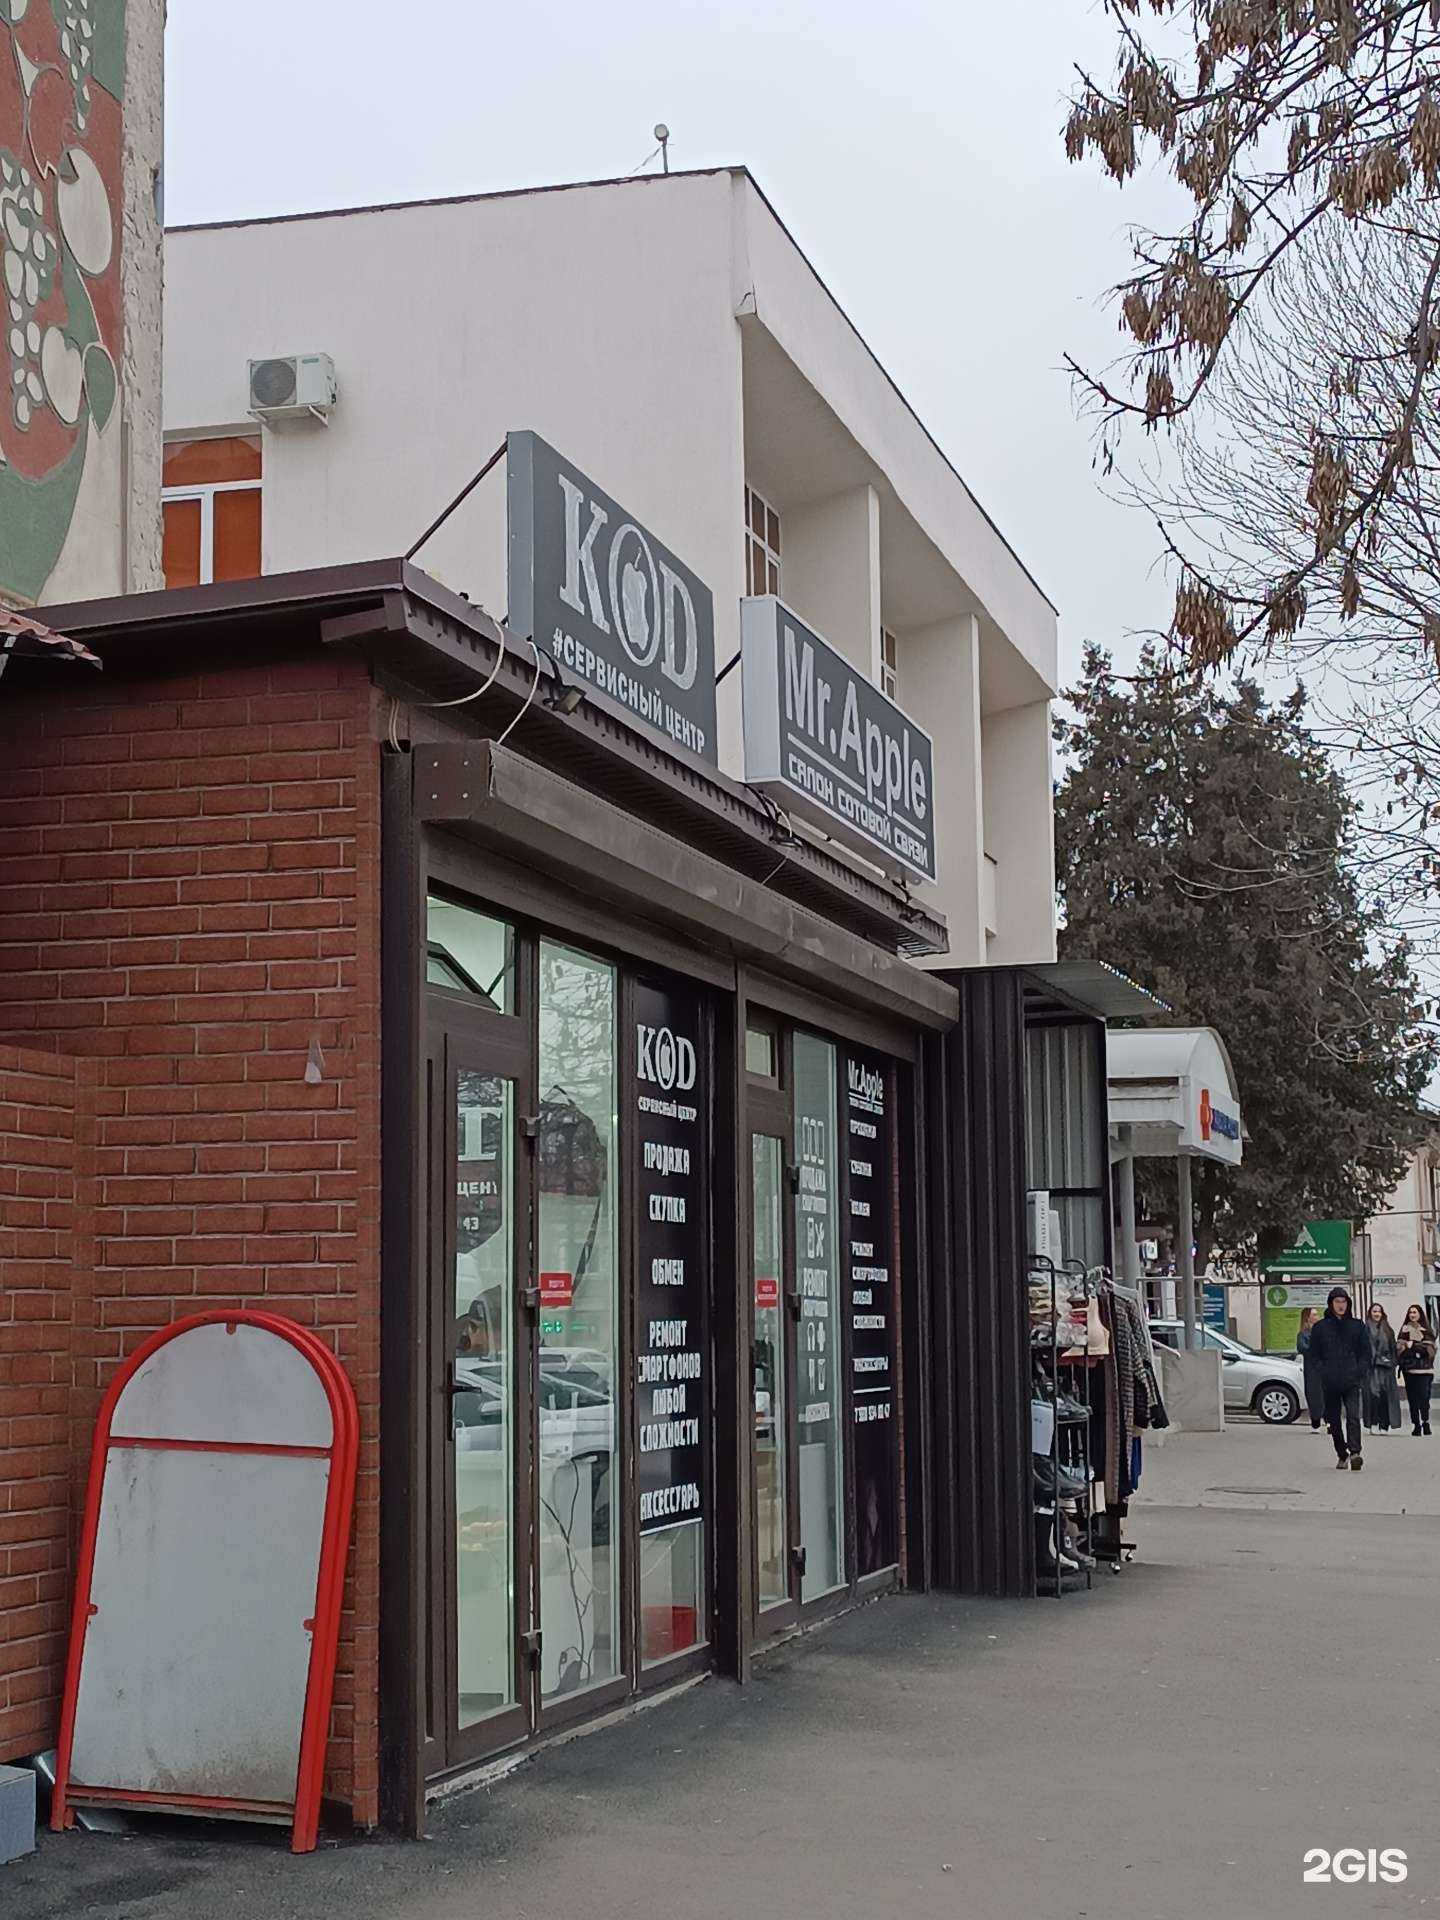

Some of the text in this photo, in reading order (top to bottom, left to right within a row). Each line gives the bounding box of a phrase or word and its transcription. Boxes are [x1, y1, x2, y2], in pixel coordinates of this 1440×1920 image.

[558, 473, 698, 691] KOD
[552, 627, 705, 755] #СЕРВИСНЫЙ ЦЕНТР
[784, 624, 926, 820] Mr.Apple
[788, 752, 928, 869] САЛОН СОТОВОЙ СВЯЗИ
[637, 1024, 696, 1091] KOD
[644, 1142, 690, 1175] ПРОДАЖА
[649, 1194, 686, 1223] СКУПКА
[652, 1258, 683, 1285] ОБМЕН
[649, 1320, 687, 1349] РЕМОНТ
[638, 1352, 701, 1383] СМАРТФОНОВ
[652, 1384, 686, 1416] ЛЮБОЙ
[640, 1418, 698, 1452] СЛОЖНОСТИ
